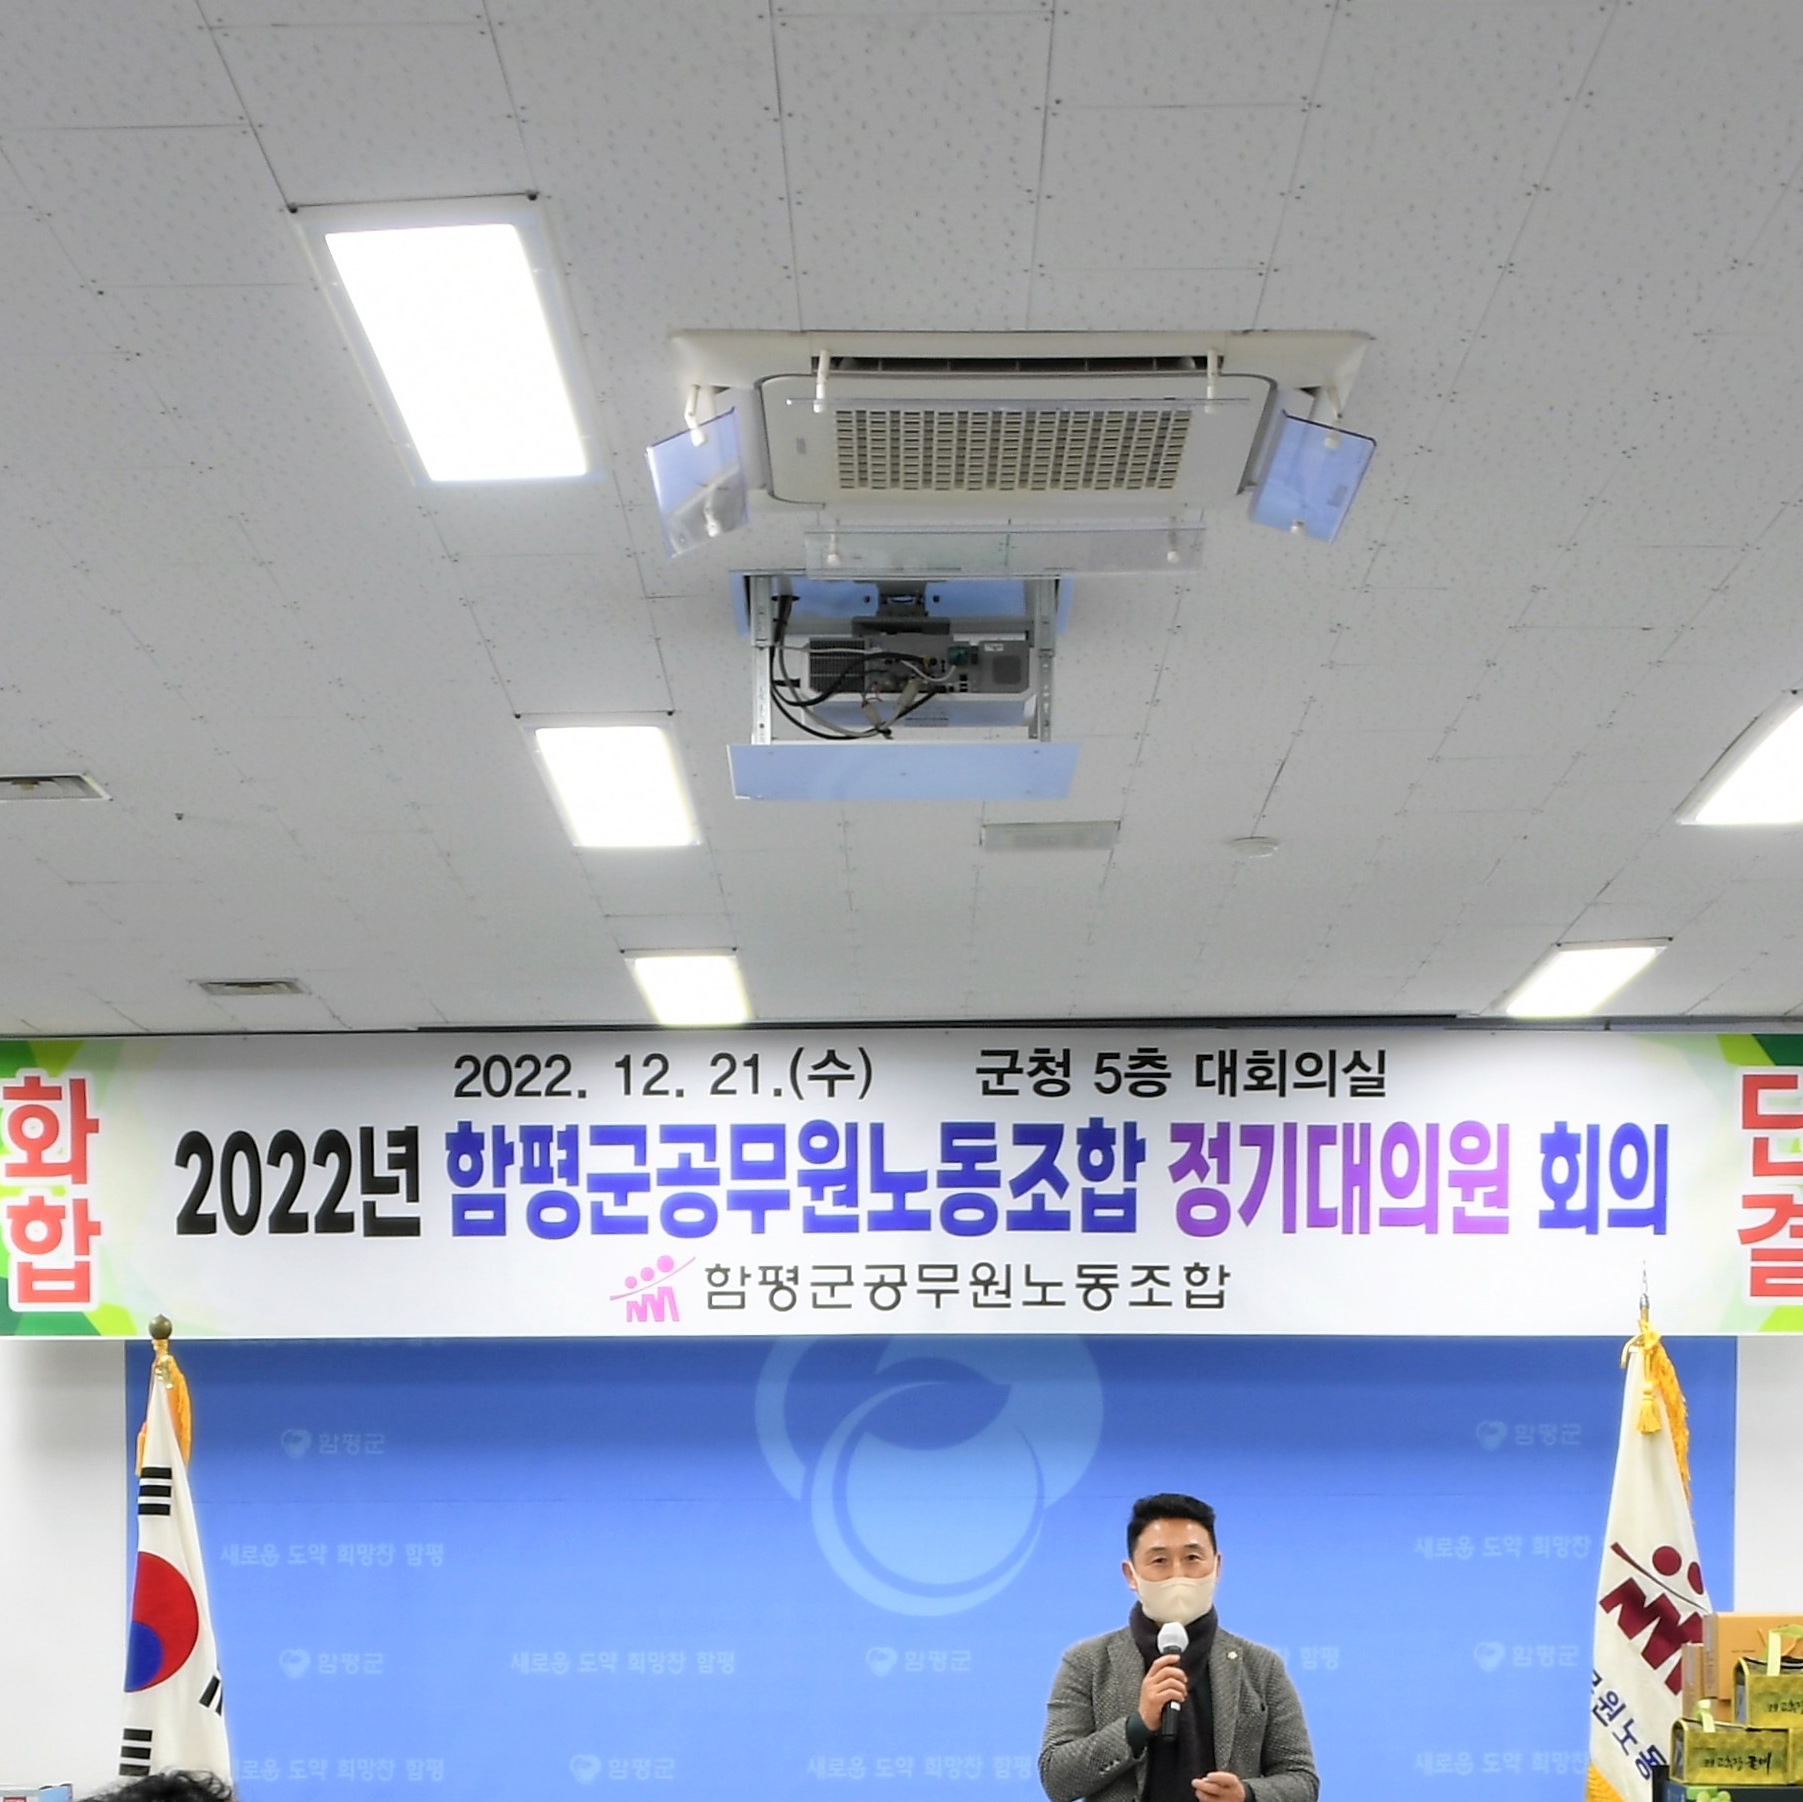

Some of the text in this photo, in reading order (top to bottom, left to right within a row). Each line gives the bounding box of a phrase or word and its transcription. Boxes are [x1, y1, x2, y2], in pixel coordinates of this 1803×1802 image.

[454, 1047, 1385, 1099] 2022. 12. 21.(수) 군청 5층 대회의실
[0, 1076, 101, 1303] 화합
[175, 1117, 1668, 1239] 2022년 함평군공무원노동조합 정기대의원 회의
[706, 1262, 1230, 1311] 함평군공무원노동조합
[318, 1433, 385, 1456] 함평군
[1515, 1424, 1581, 1446] 함평군
[221, 1544, 444, 1568] 새로운 도약 희망찬 함평
[1414, 1536, 1590, 1560] 새로운 도약 희망찬
[318, 1652, 383, 1674] 함평군
[510, 1650, 735, 1675] 새로운 도약 희망찬 함평
[905, 1650, 971, 1673] 함평군
[1511, 1645, 1578, 1668] 함평군
[234, 1758, 444, 1782] 로운 도약 희망찬 함평
[609, 1757, 674, 1780] 함평군
[807, 1756, 866, 1780] 새로운
[875, 1757, 914, 1778] 도약
[925, 1755, 983, 1779] 희망찬
[1482, 1750, 1523, 1774] 도약
